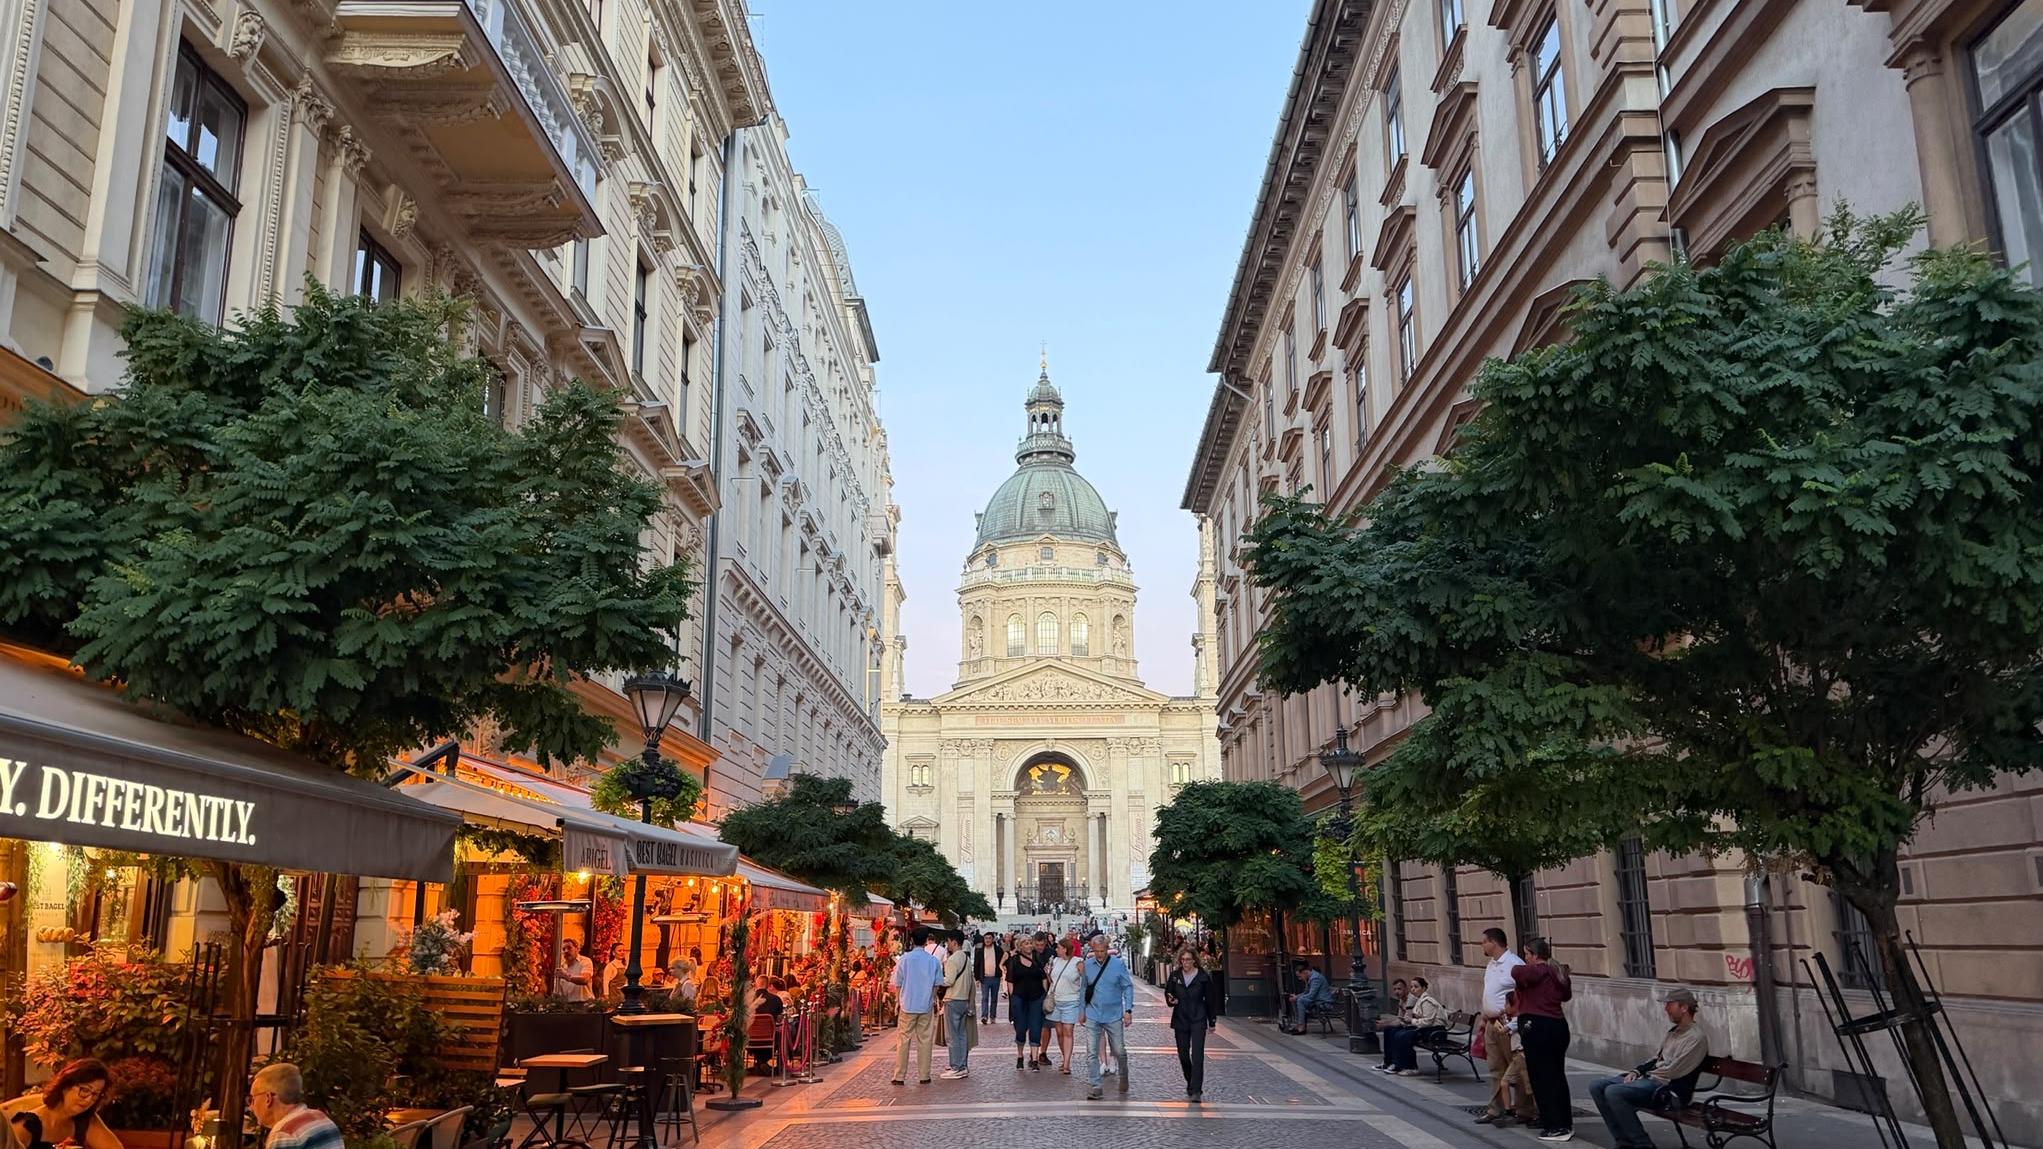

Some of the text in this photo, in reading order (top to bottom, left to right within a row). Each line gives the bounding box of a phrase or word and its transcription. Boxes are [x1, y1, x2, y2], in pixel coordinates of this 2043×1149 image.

[36, 766, 256, 845] DIFFERENTLY.
[636, 840, 656, 865] BEST
[657, 841, 678, 866] BAGEL
[680, 847, 714, 870] BASILICA
